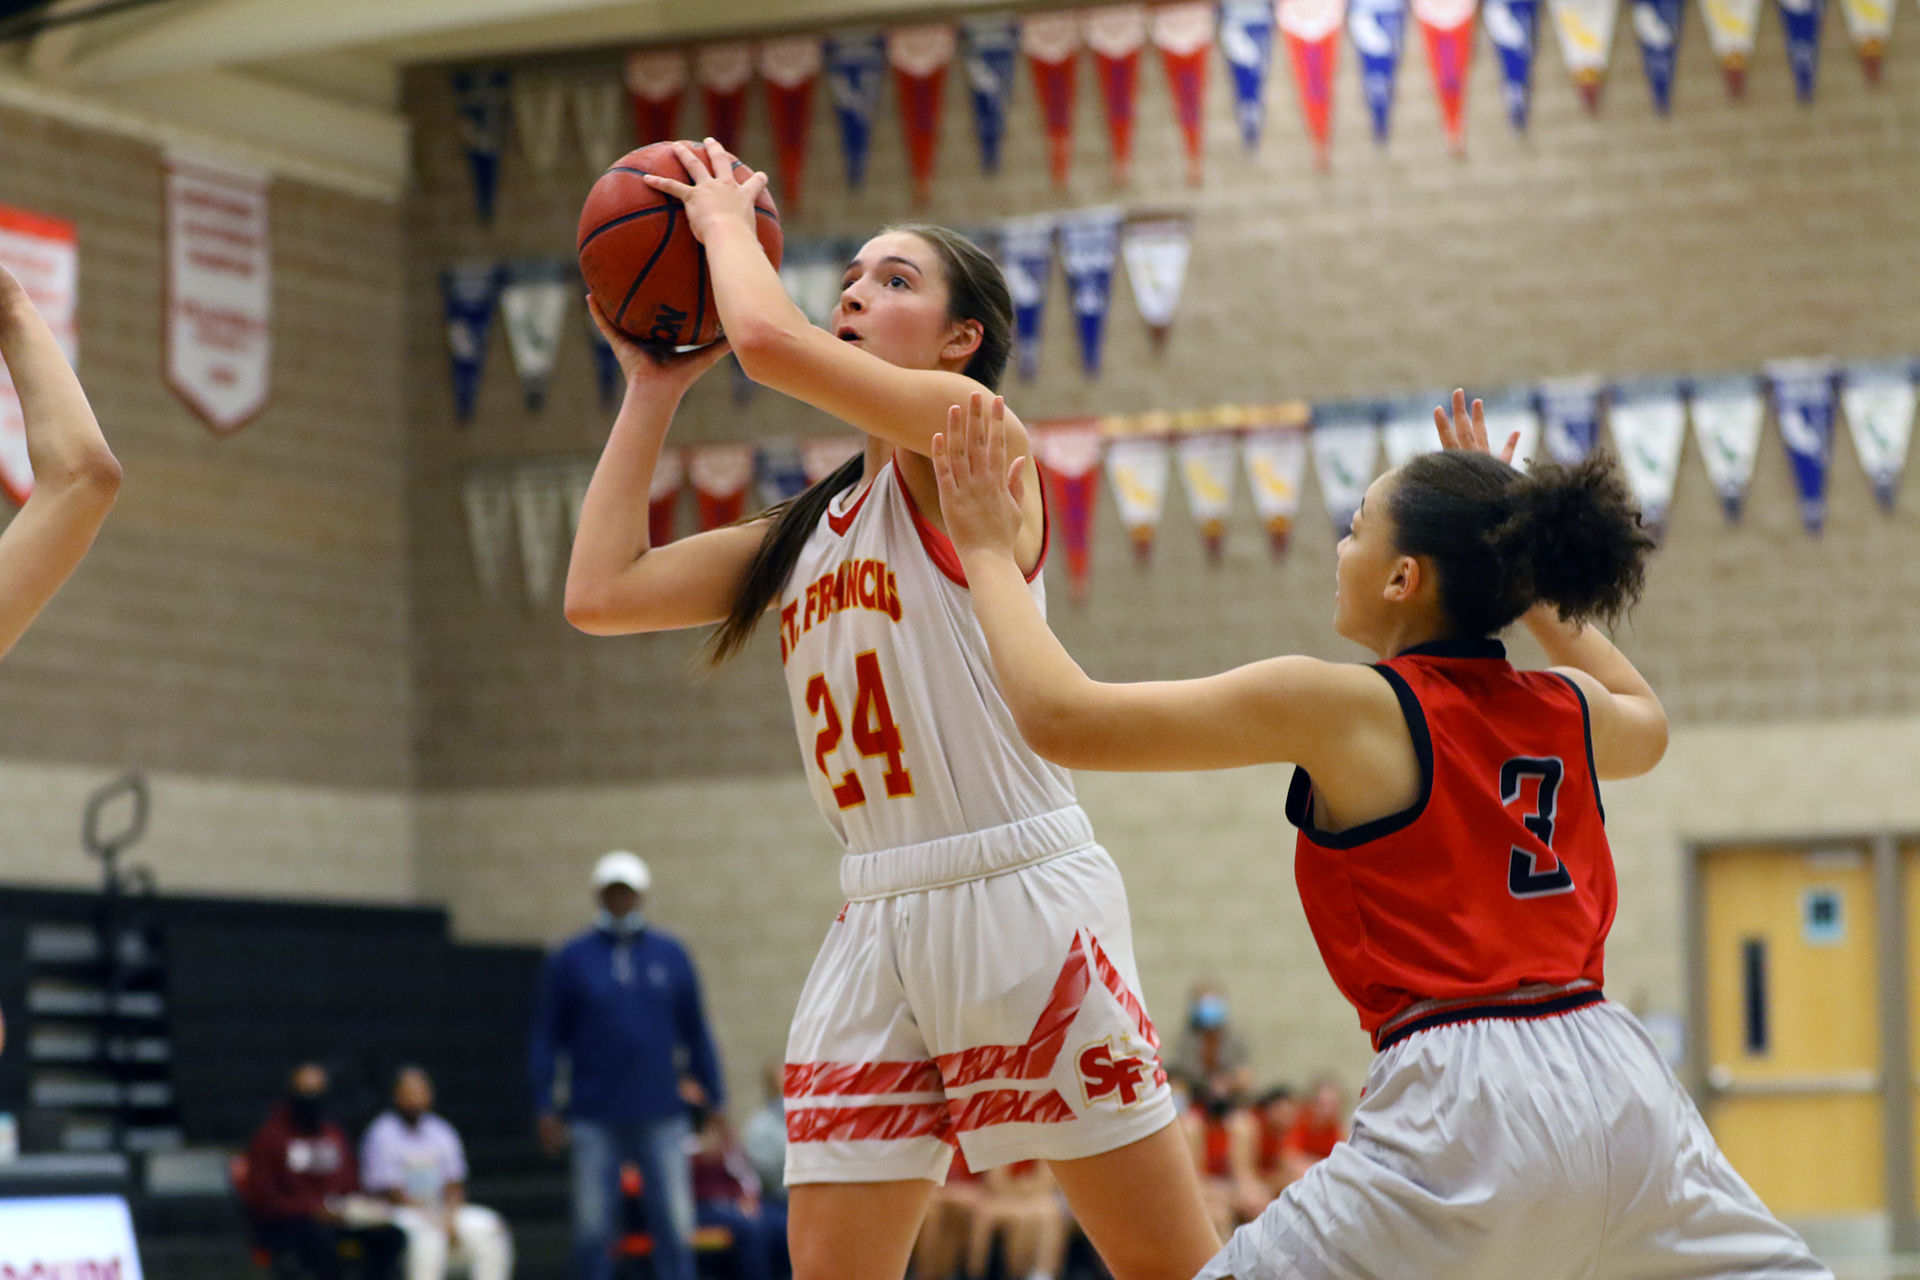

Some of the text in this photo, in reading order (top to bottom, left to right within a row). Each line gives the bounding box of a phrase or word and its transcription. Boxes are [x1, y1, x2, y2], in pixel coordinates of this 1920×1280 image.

[804, 559, 903, 632] FRANCIS
[805, 648, 915, 811] 24
[1499, 756, 1575, 899] 3
[1075, 1037, 1148, 1111] SF
